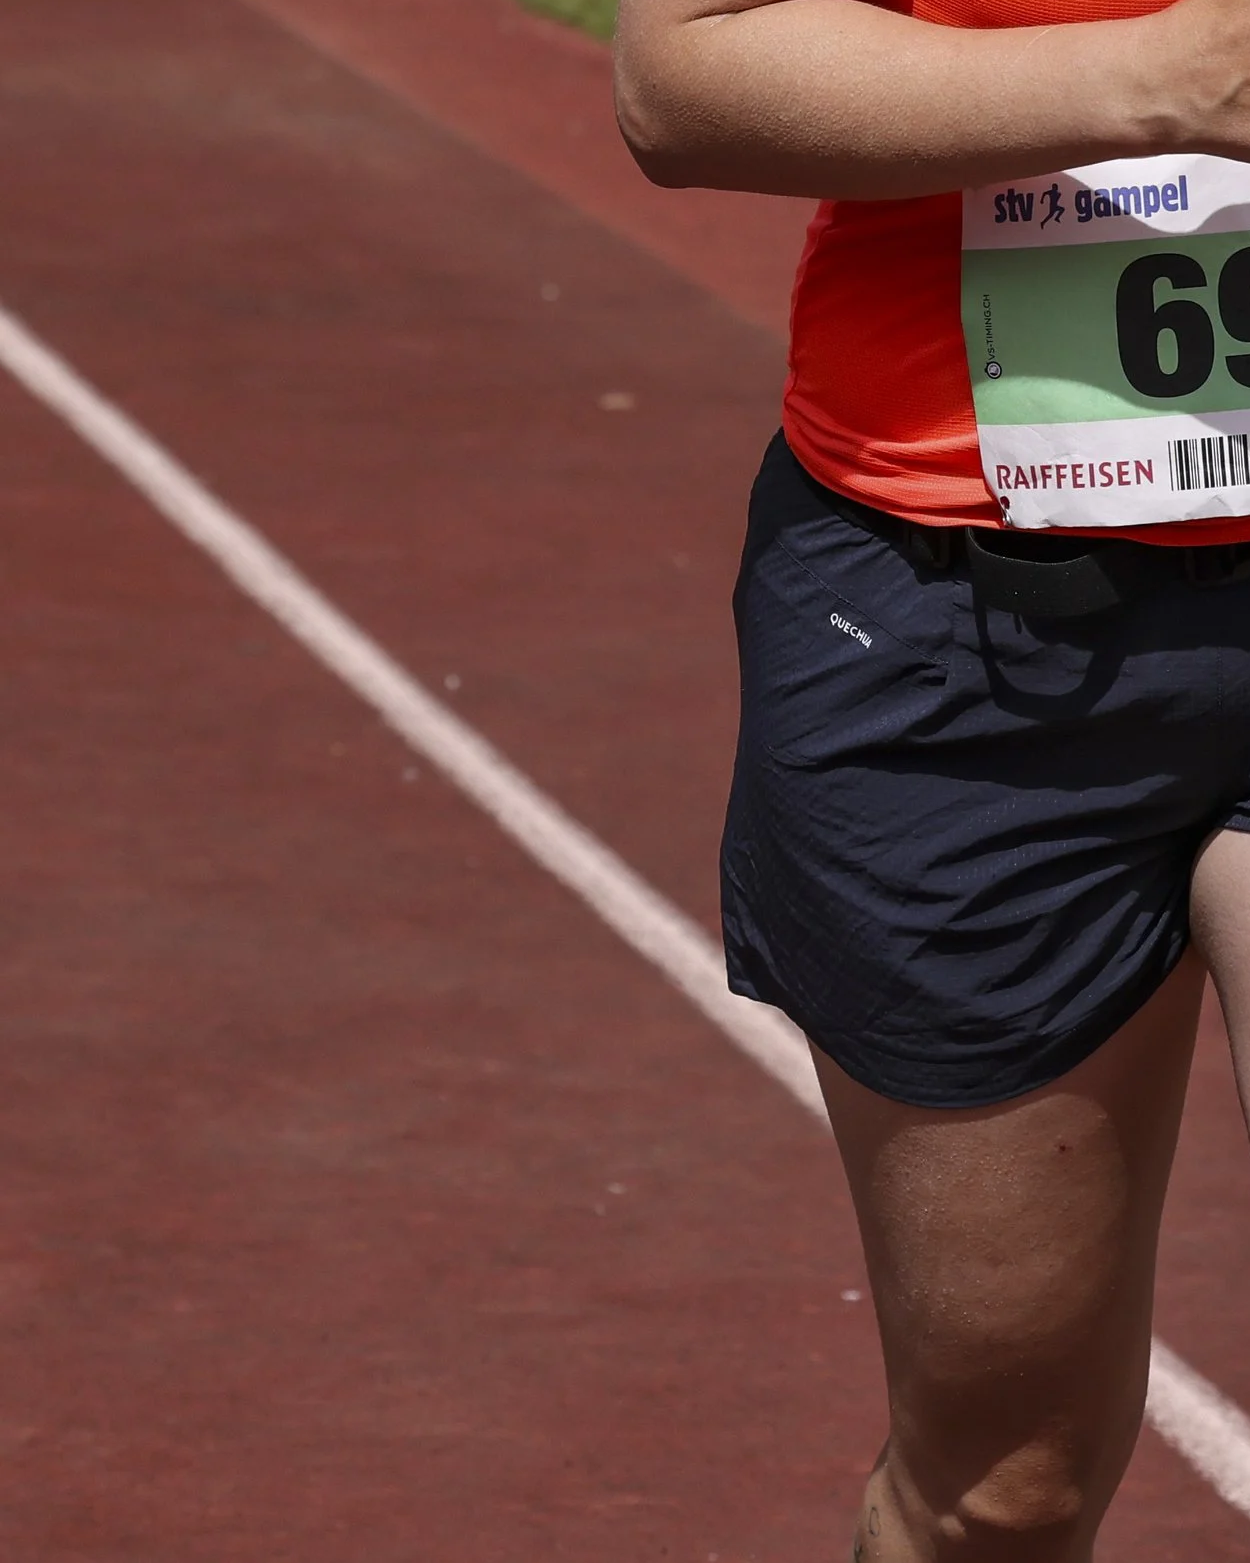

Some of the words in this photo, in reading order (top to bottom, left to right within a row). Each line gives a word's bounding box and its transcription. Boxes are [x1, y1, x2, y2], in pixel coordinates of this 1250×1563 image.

[994, 188, 1034, 224] stv
[1075, 175, 1189, 223] gampel
[983, 294, 996, 360] VS-TIMING.CH
[995, 459, 1155, 490] RAIFFEISEN
[829, 612, 873, 649] QUECHUA
